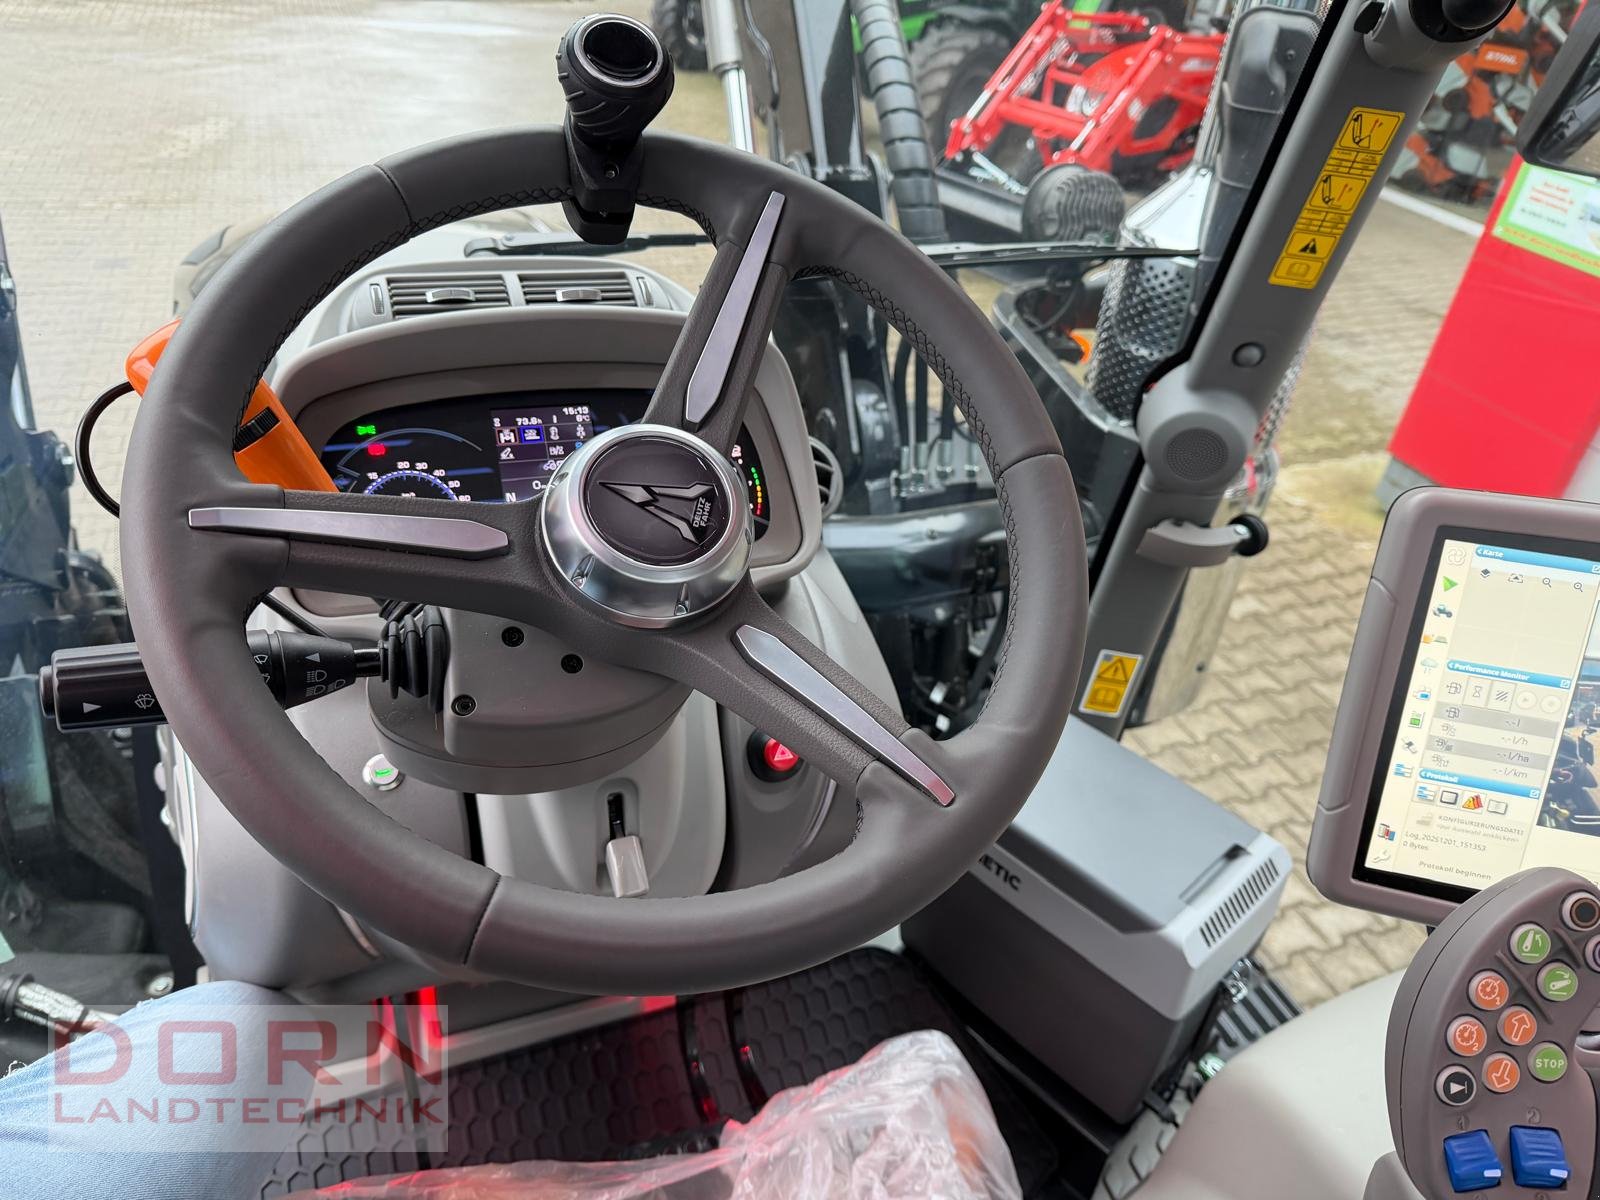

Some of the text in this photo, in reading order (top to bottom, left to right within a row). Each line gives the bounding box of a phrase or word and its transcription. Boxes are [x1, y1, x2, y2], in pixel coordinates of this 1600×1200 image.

[562, 406, 589, 415] 15:13
[397, 461, 410, 469] 20
[415, 462, 428, 470] 30
[433, 469, 446, 477] 40
[505, 492, 517, 502] N
[693, 497, 706, 527] DEUTZ
[700, 501, 711, 527] FAHR
[1483, 549, 1504, 558] Karte
[1453, 663, 1530, 681] Performance Monitor
[979, 853, 1021, 891] ETIC
[1418, 860, 1492, 881] Protokoll beginnen
[1535, 1058, 1565, 1069] STOP
